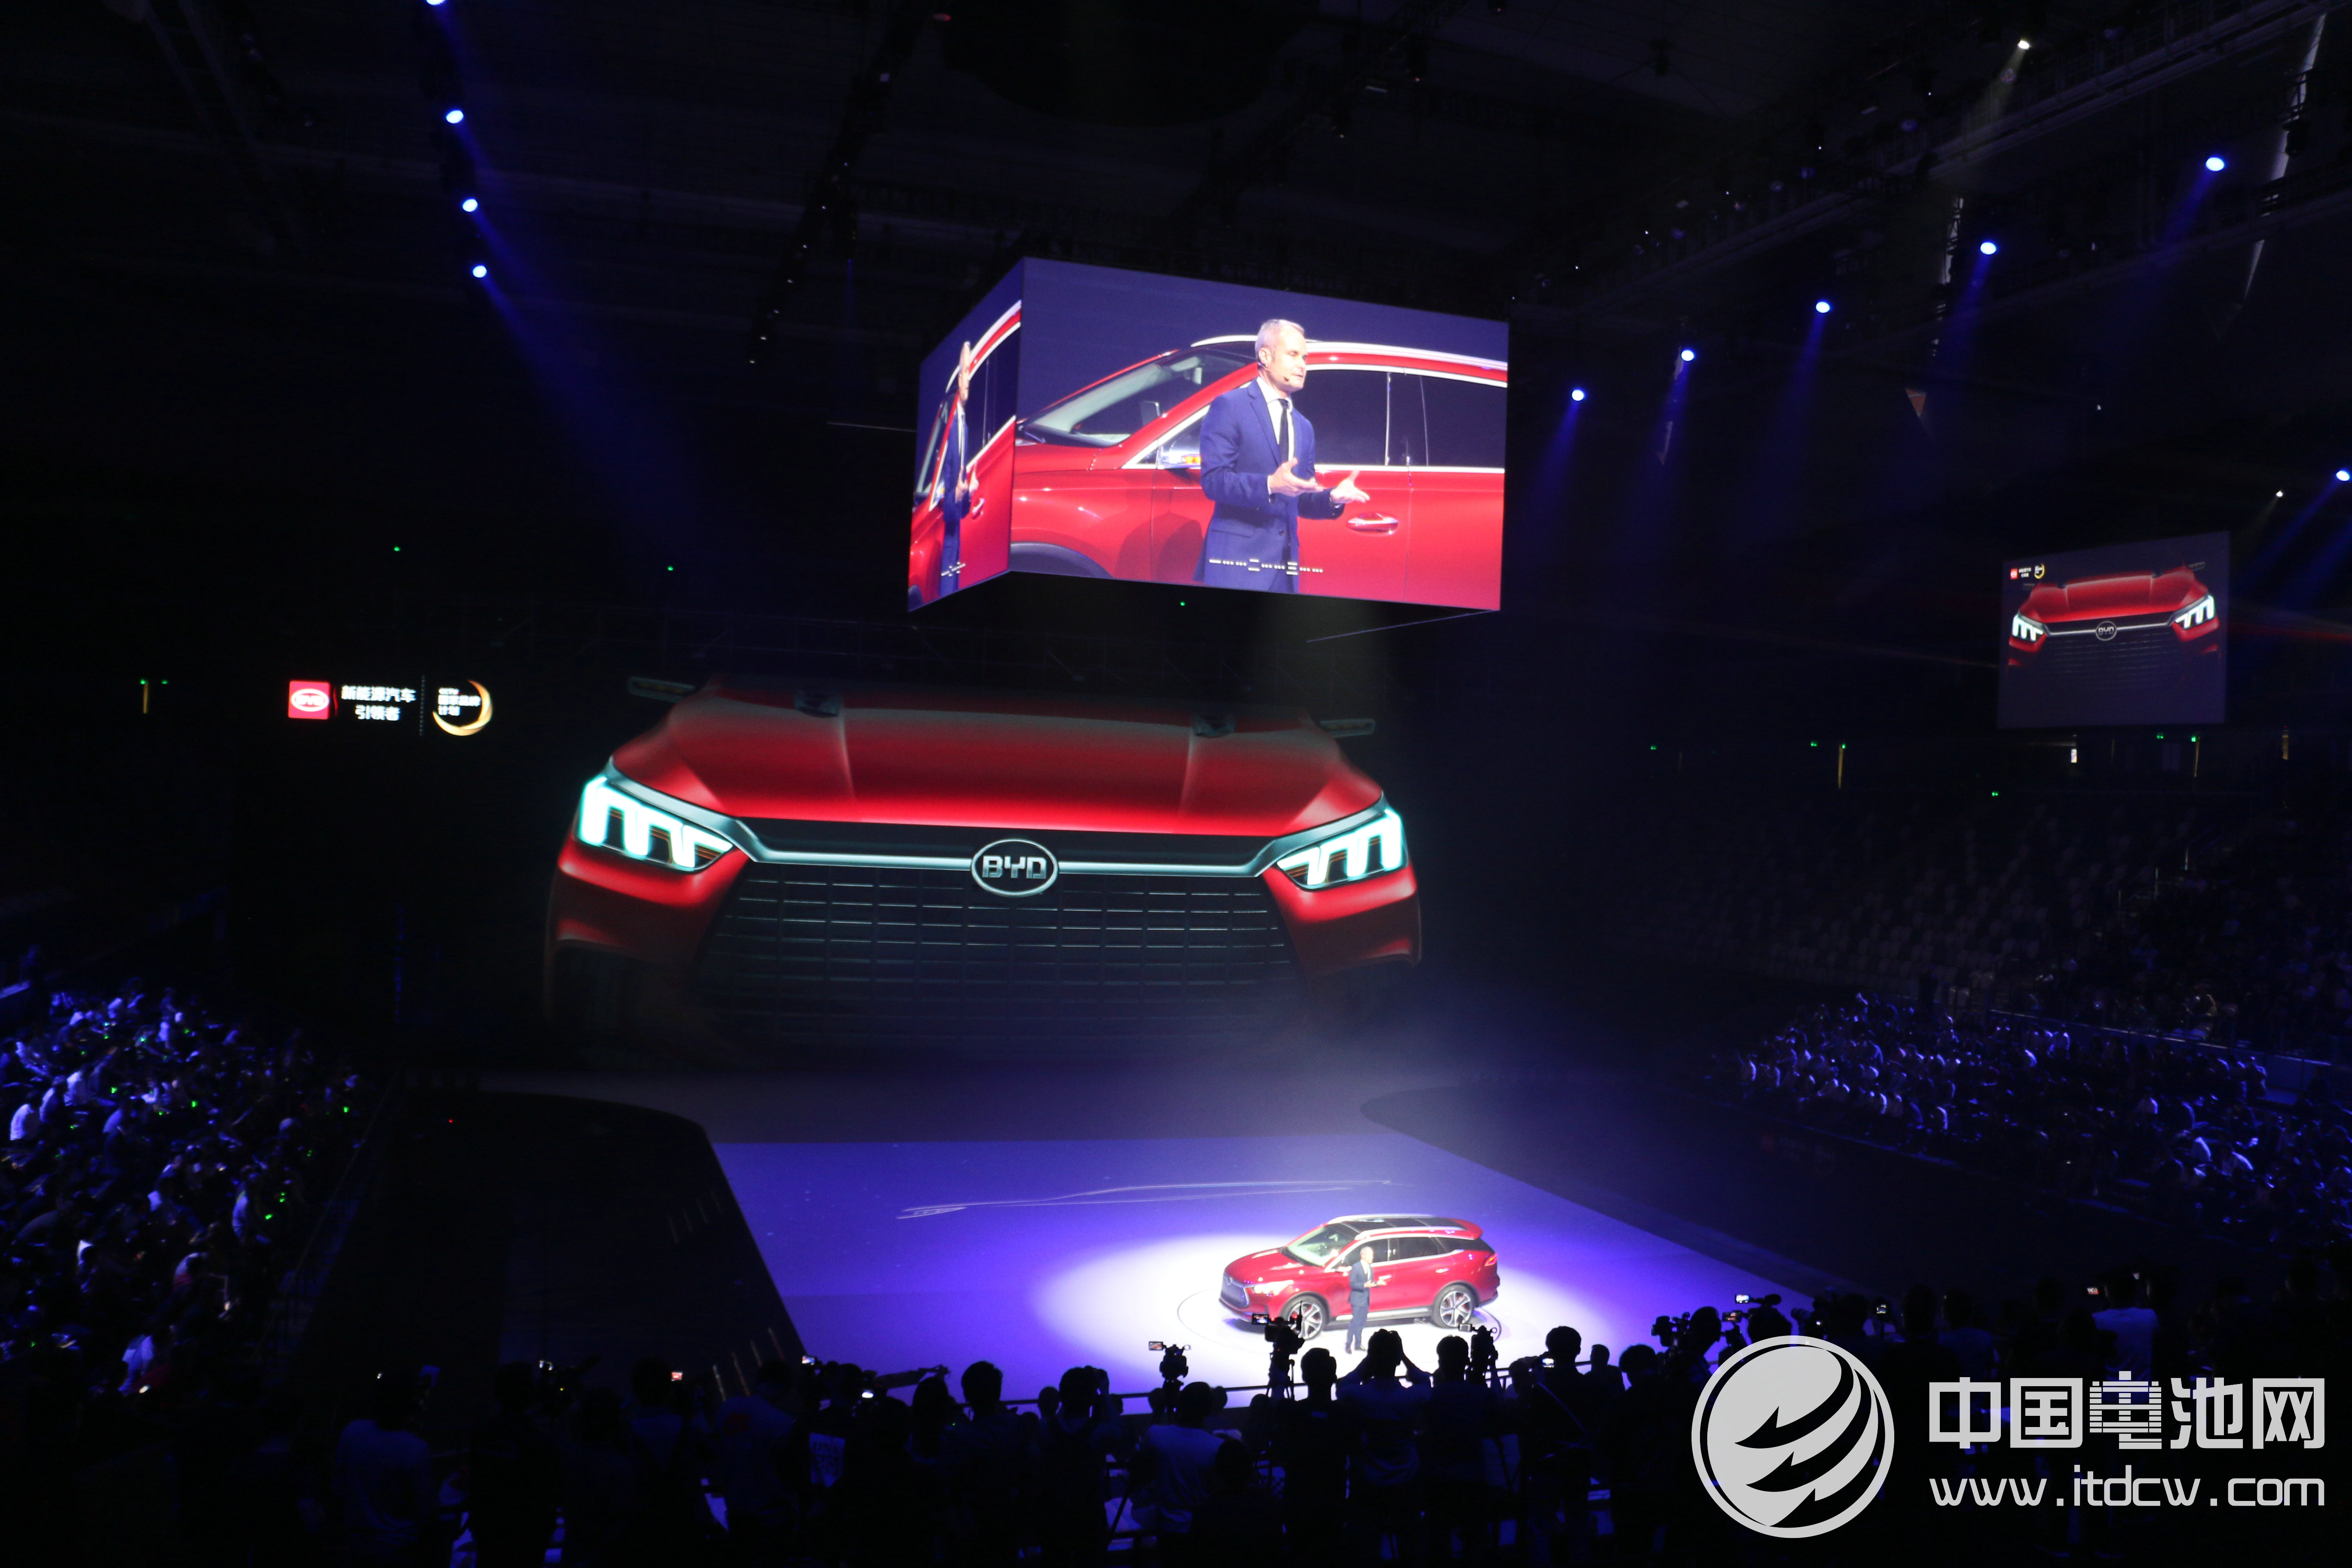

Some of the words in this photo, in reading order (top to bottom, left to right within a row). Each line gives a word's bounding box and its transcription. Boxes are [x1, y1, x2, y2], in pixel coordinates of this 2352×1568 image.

[2098, 626, 2114, 635] BYD
[341, 685, 416, 703] 新能源汽车
[355, 704, 401, 721] 引领者
[982, 855, 1047, 879] BYD
